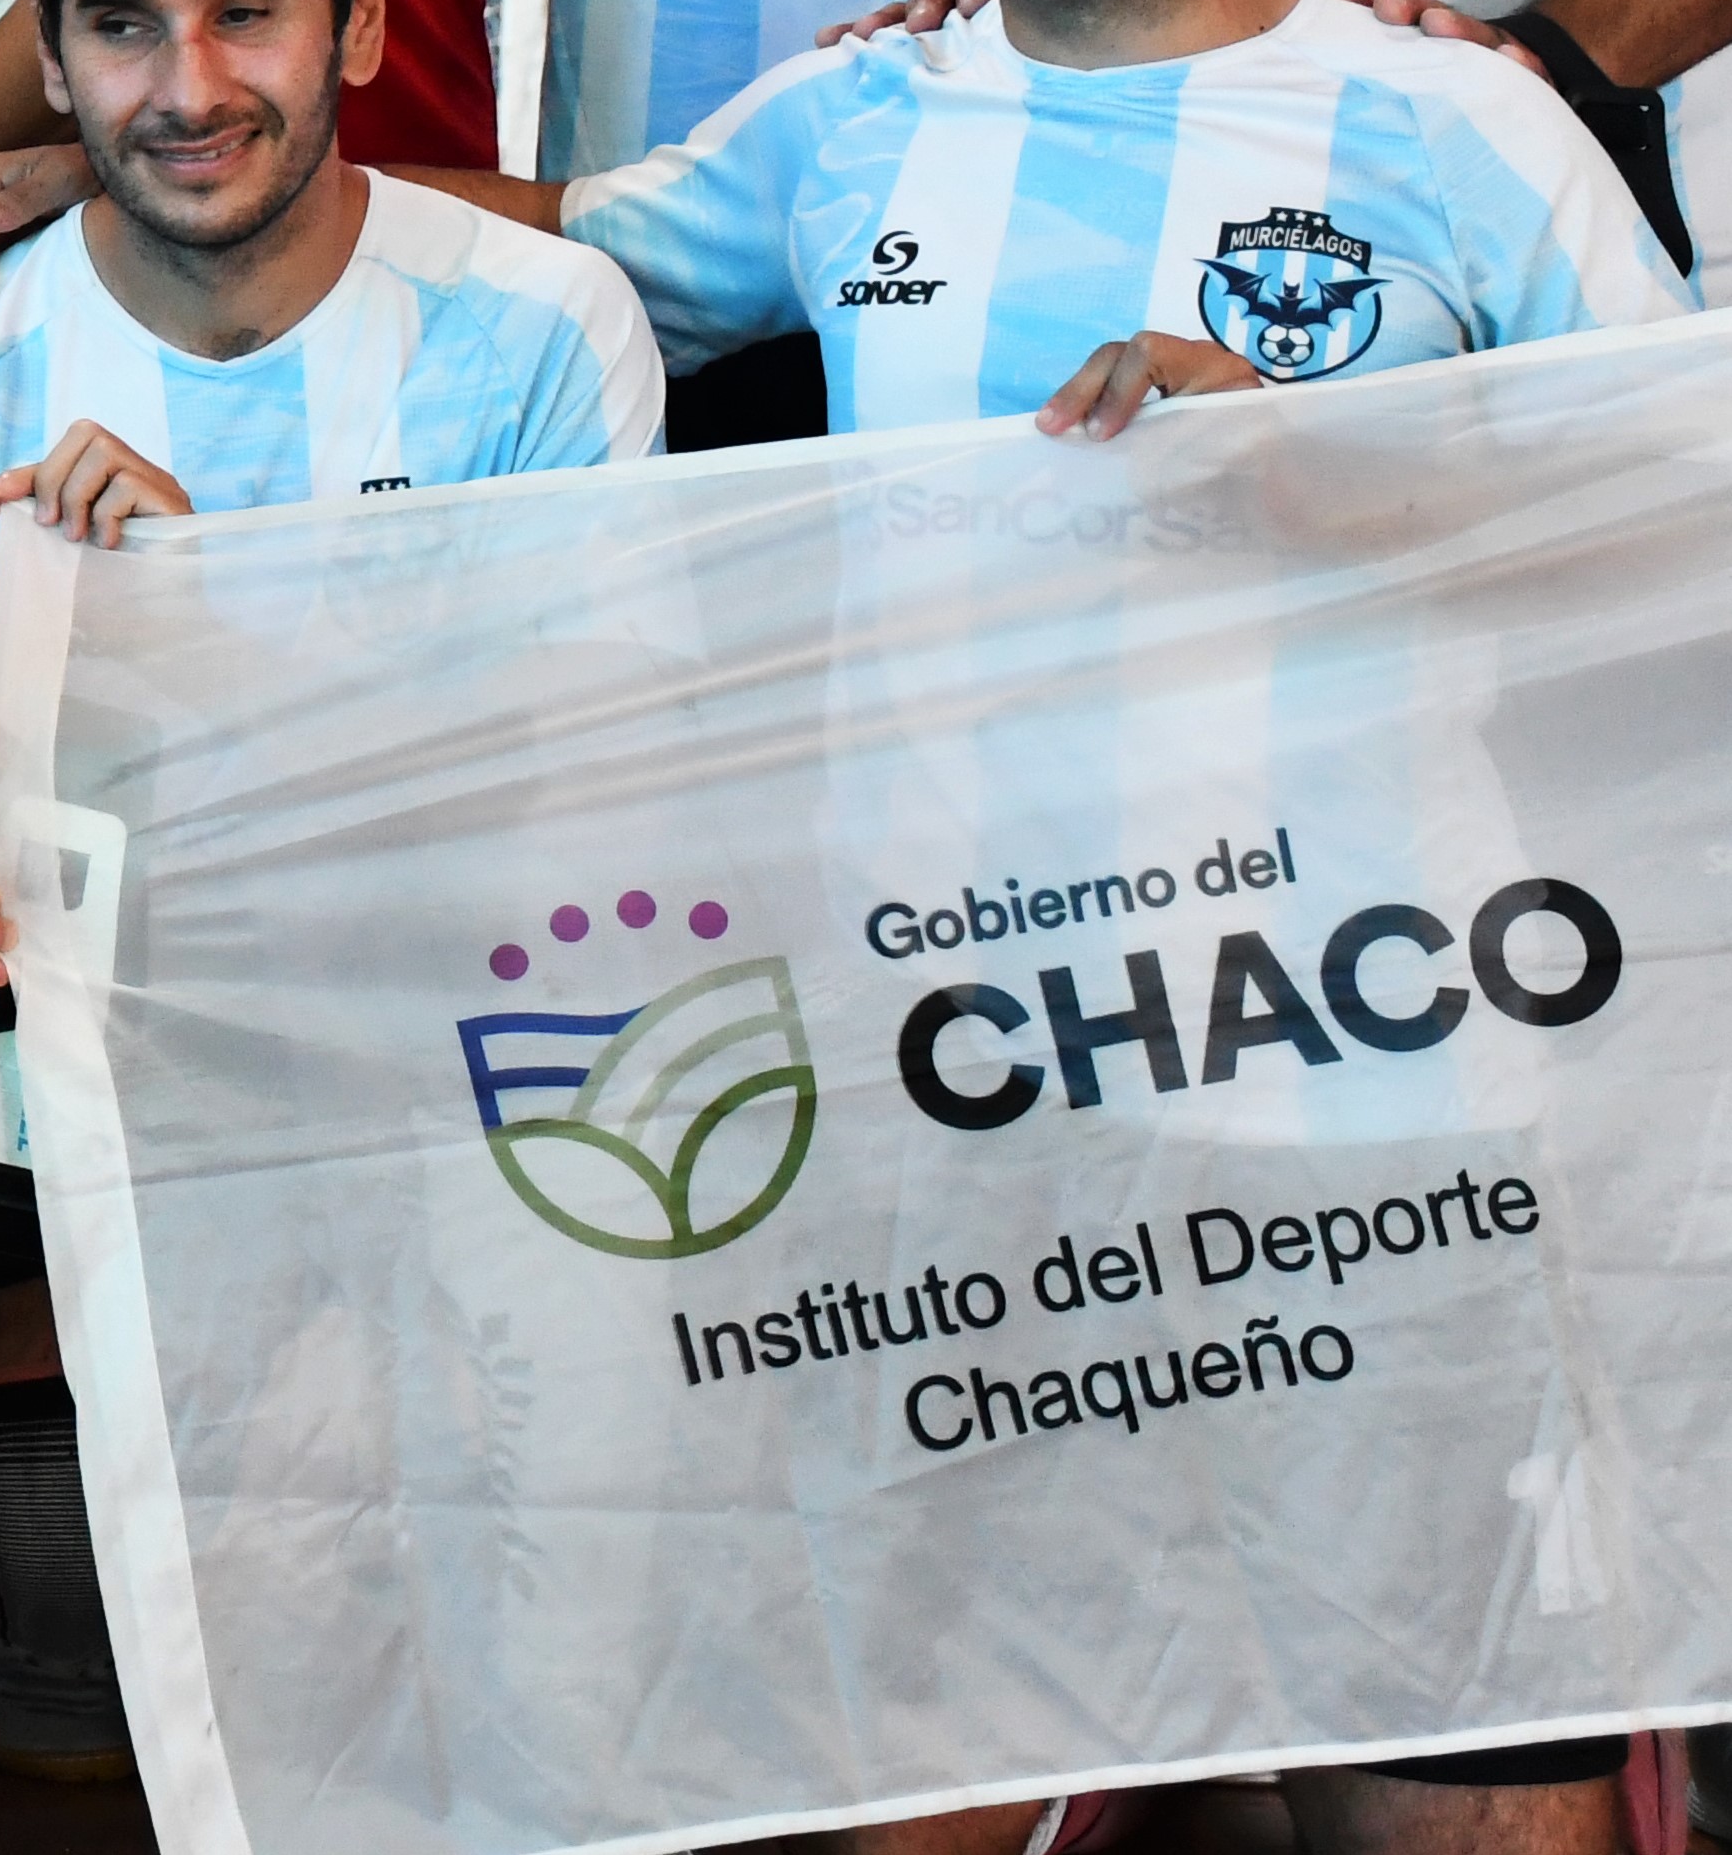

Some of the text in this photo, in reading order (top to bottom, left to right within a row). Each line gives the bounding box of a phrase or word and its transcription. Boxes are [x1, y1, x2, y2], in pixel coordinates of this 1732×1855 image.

[1229, 224, 1364, 262] MURCIÉLAGOS
[866, 827, 1297, 961] Gobierno del
[896, 877, 1623, 1132] CHACO
[673, 1168, 1541, 1386] Instituto del Deporte
[904, 1315, 1355, 1453] Chaqueño
